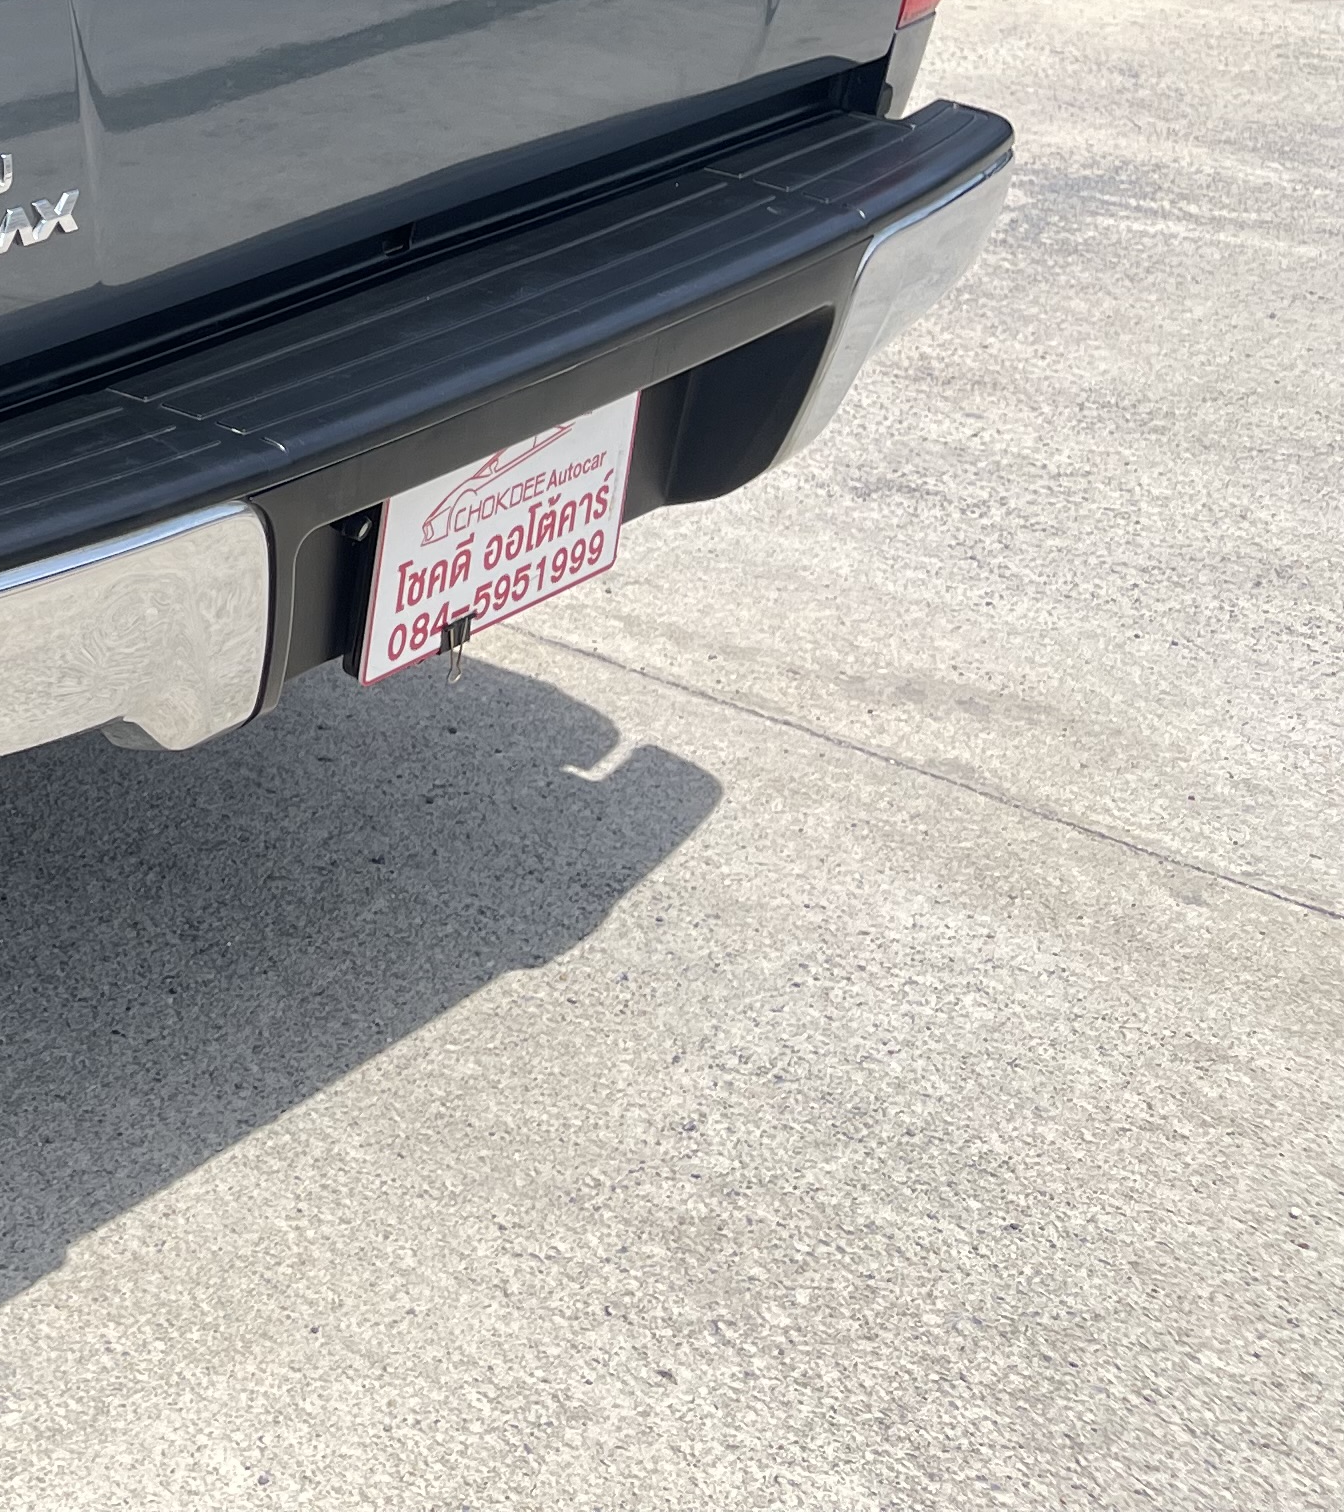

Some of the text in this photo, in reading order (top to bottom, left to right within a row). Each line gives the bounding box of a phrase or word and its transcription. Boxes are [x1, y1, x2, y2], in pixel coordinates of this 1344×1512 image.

[394, 467, 615, 614] โชคดี ออโต้คาร์
[453, 450, 608, 533] CHOKDEE Autocar
[387, 528, 605, 662] 084-5951999
